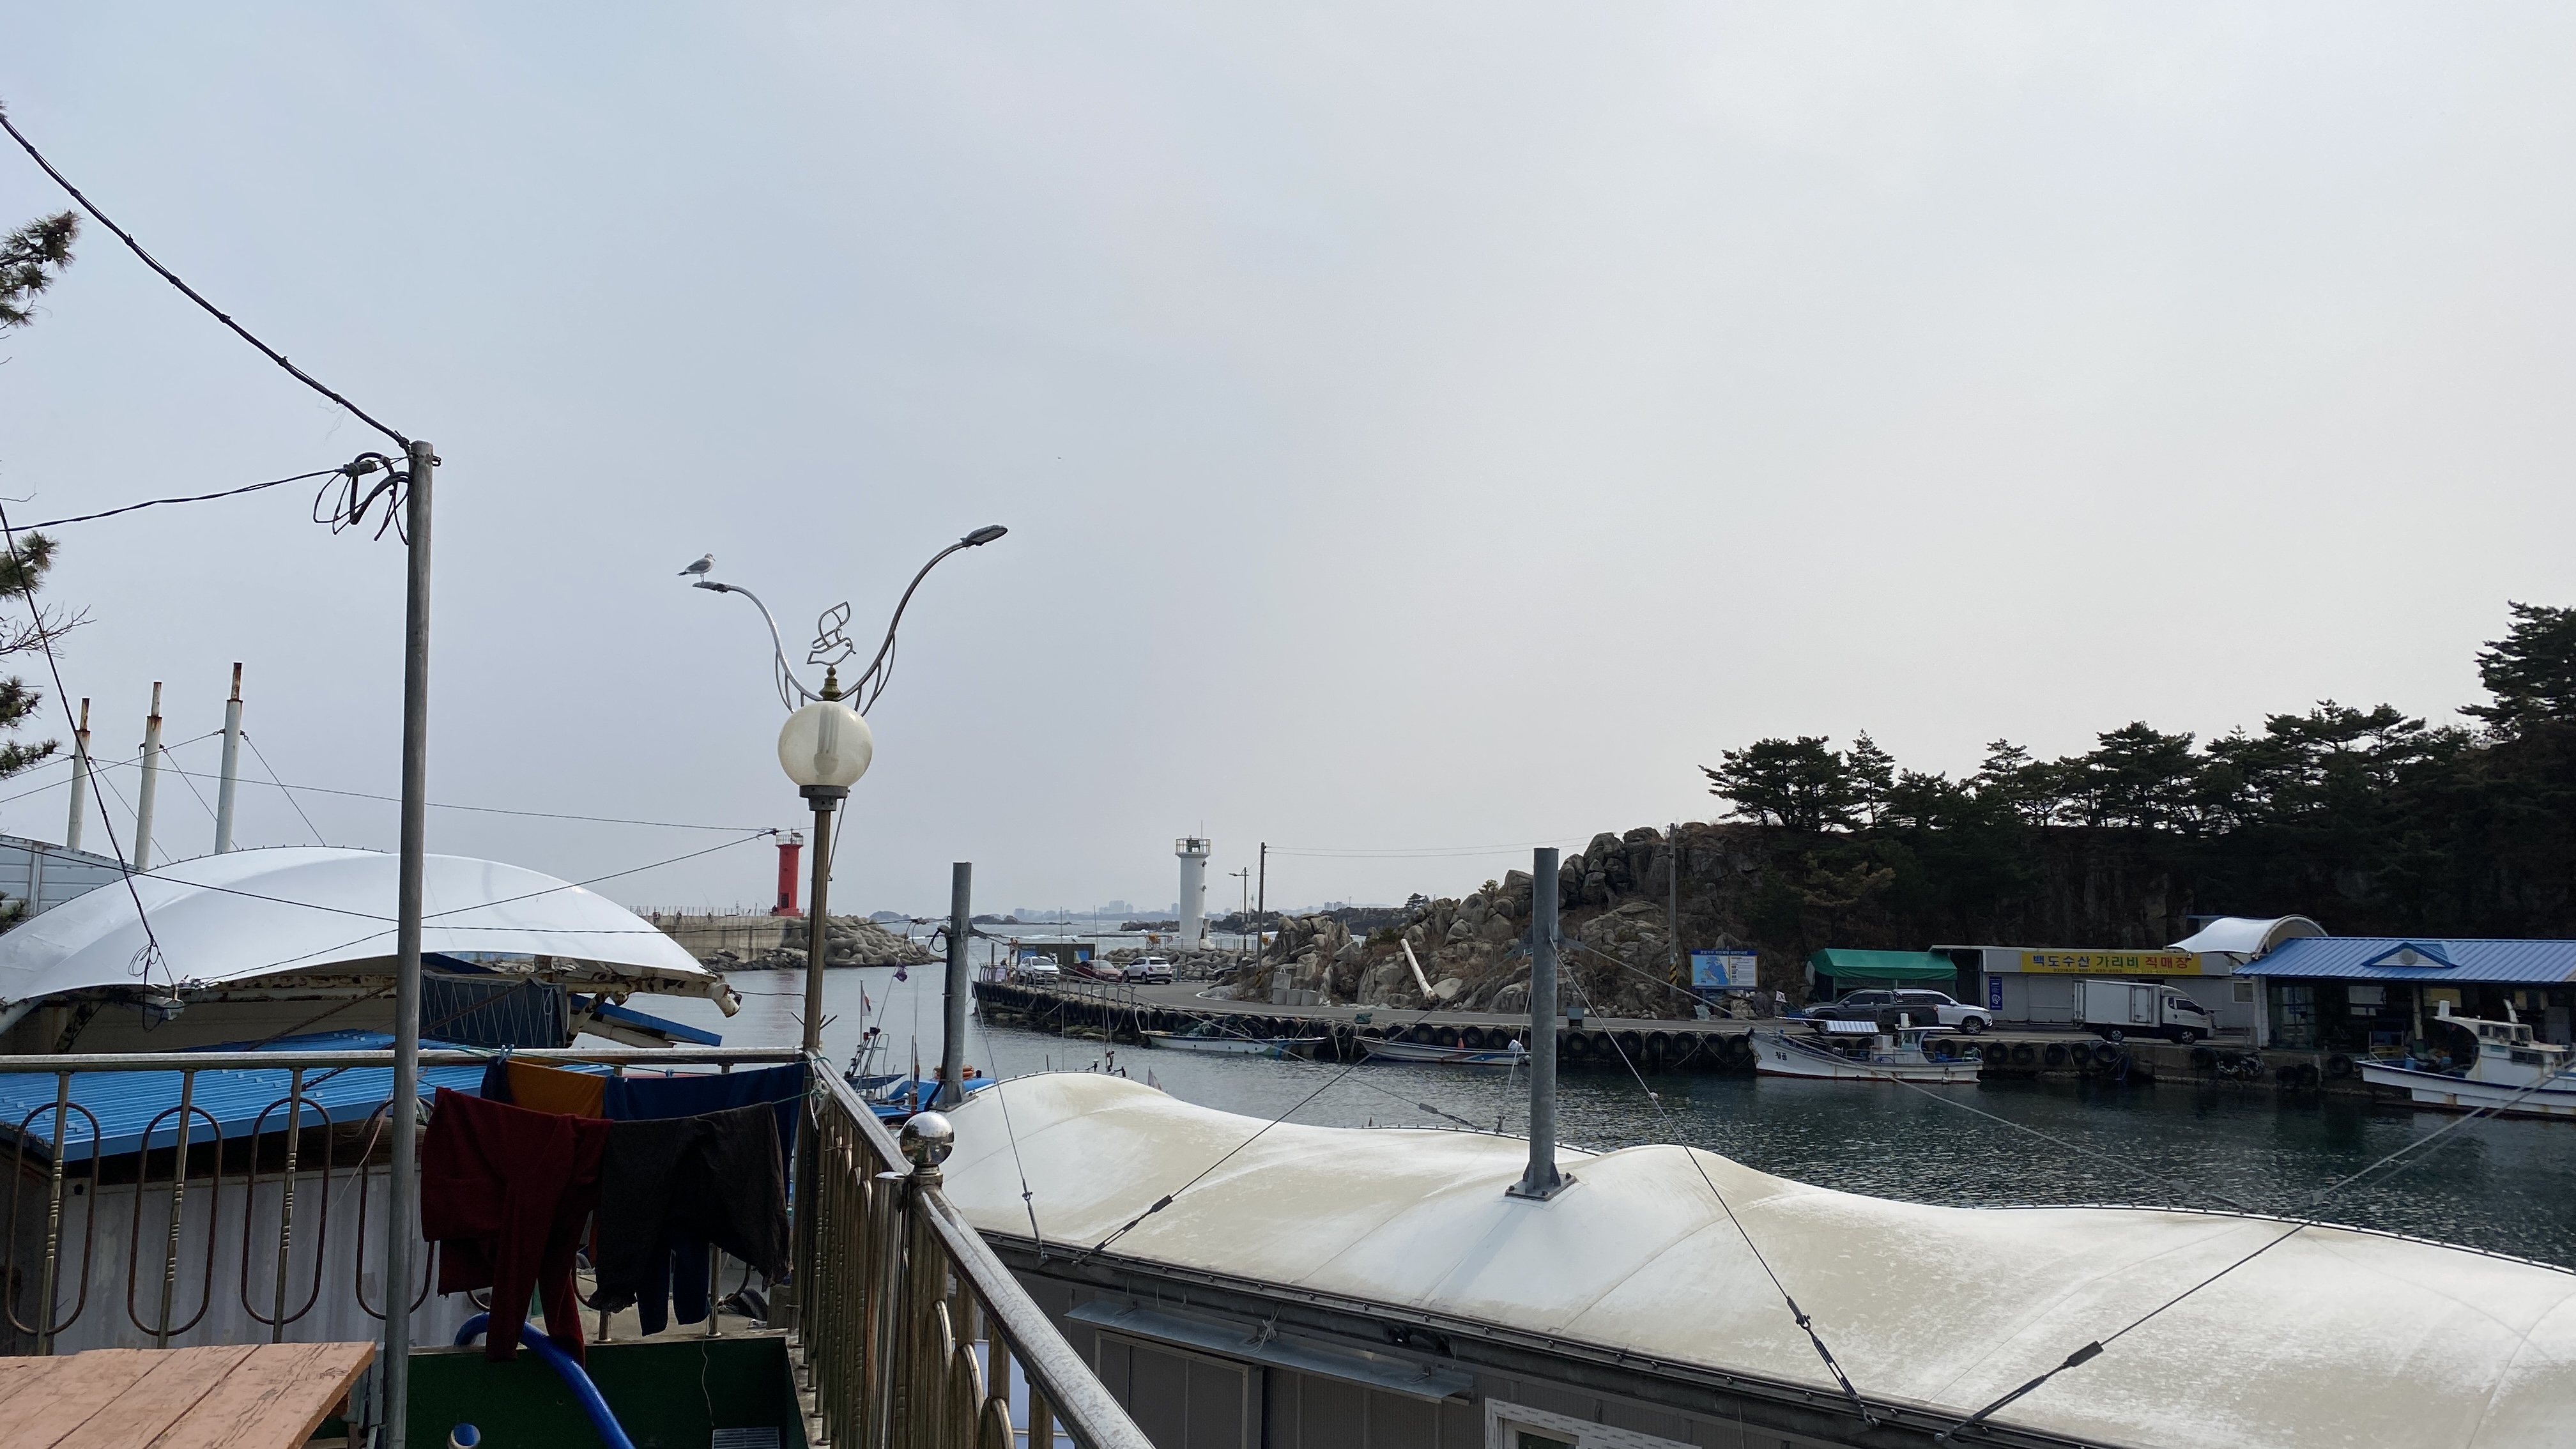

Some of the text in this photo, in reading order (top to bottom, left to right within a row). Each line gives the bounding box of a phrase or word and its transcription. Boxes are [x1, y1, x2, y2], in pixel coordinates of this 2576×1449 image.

[2033, 955, 2189, 969] 백도수산 가리비 직매장
